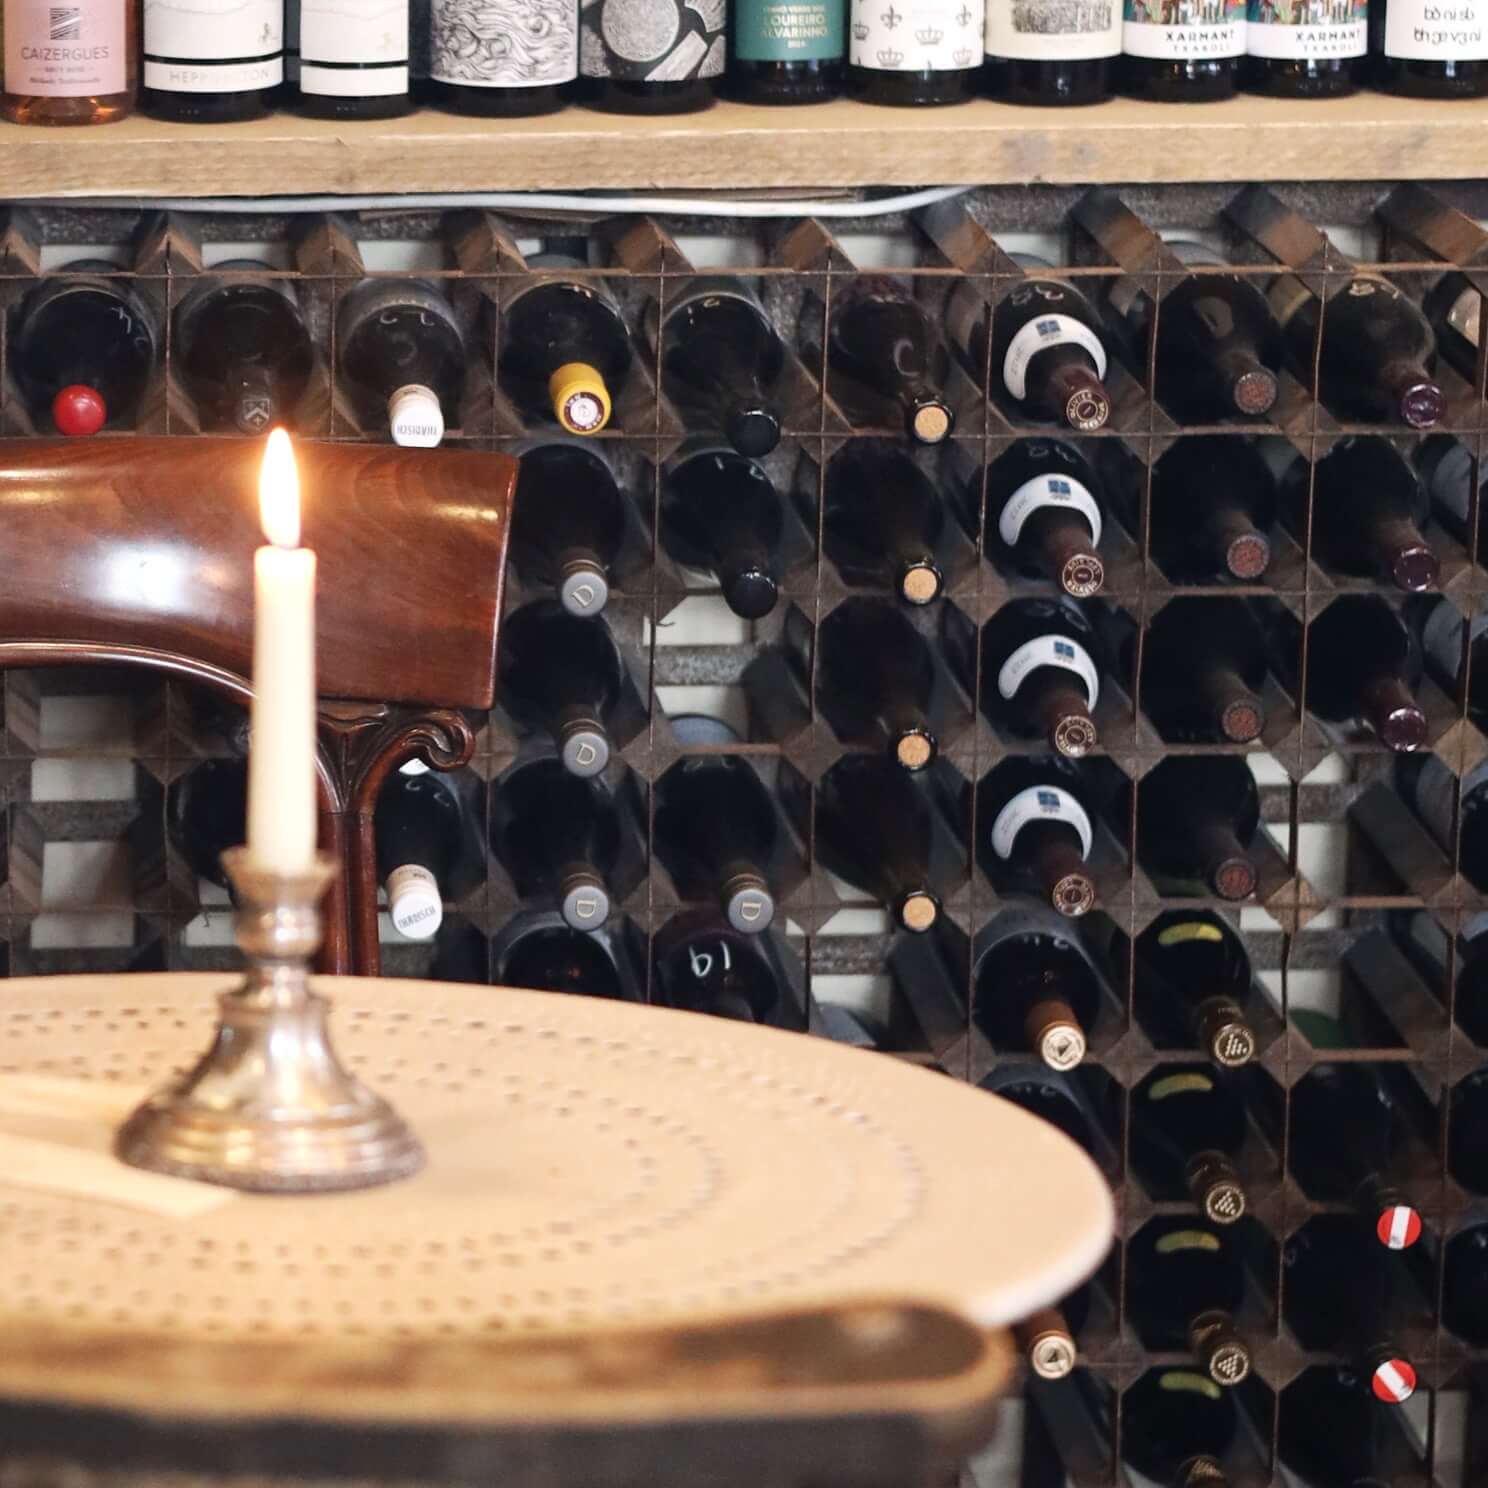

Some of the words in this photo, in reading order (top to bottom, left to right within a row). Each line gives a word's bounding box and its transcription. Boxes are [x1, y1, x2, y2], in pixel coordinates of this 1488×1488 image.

[1165, 30, 1237, 44] XARMANT
[1295, 29, 1362, 44] XARMANT
[20, 45, 110, 62] CAIZERGUES
[575, 741, 596, 766] D
